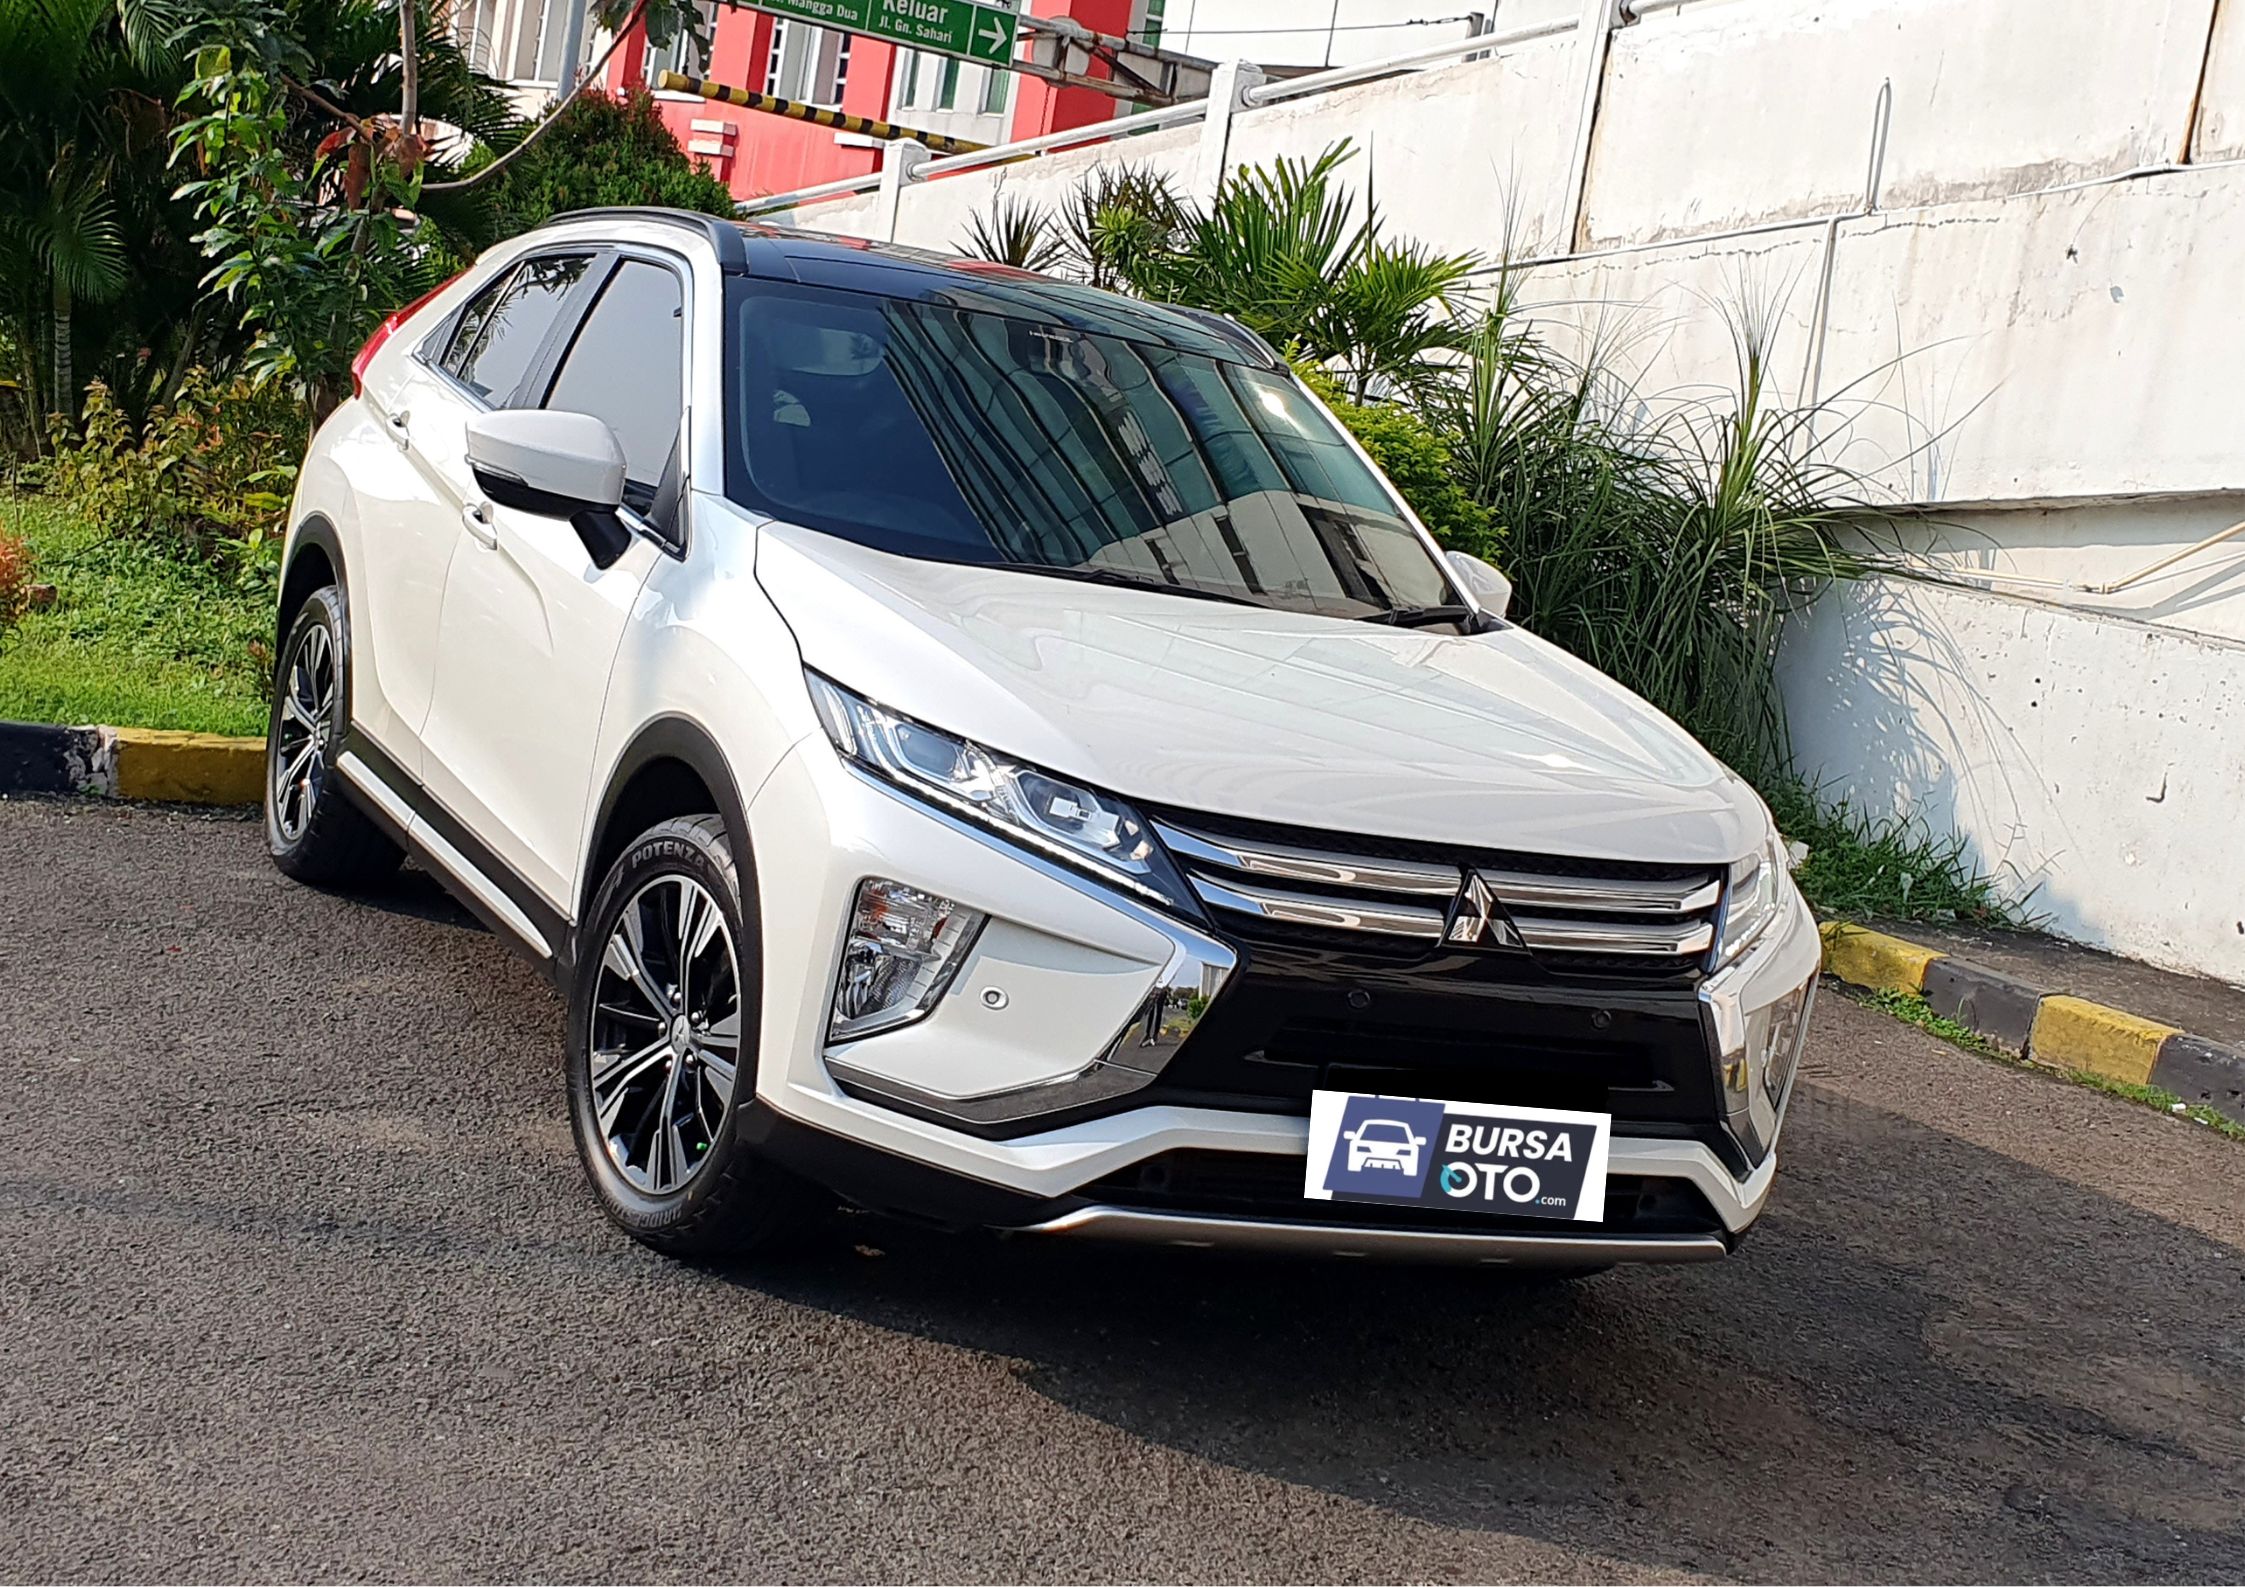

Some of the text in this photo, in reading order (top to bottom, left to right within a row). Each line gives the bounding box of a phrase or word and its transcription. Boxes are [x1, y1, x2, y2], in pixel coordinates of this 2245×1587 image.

[837, 4, 858, 20] Dua
[883, 0, 948, 23] Keluar
[879, 15, 953, 43] Jl. Gn. Sahari
[632, 841, 705, 870] POTENZA
